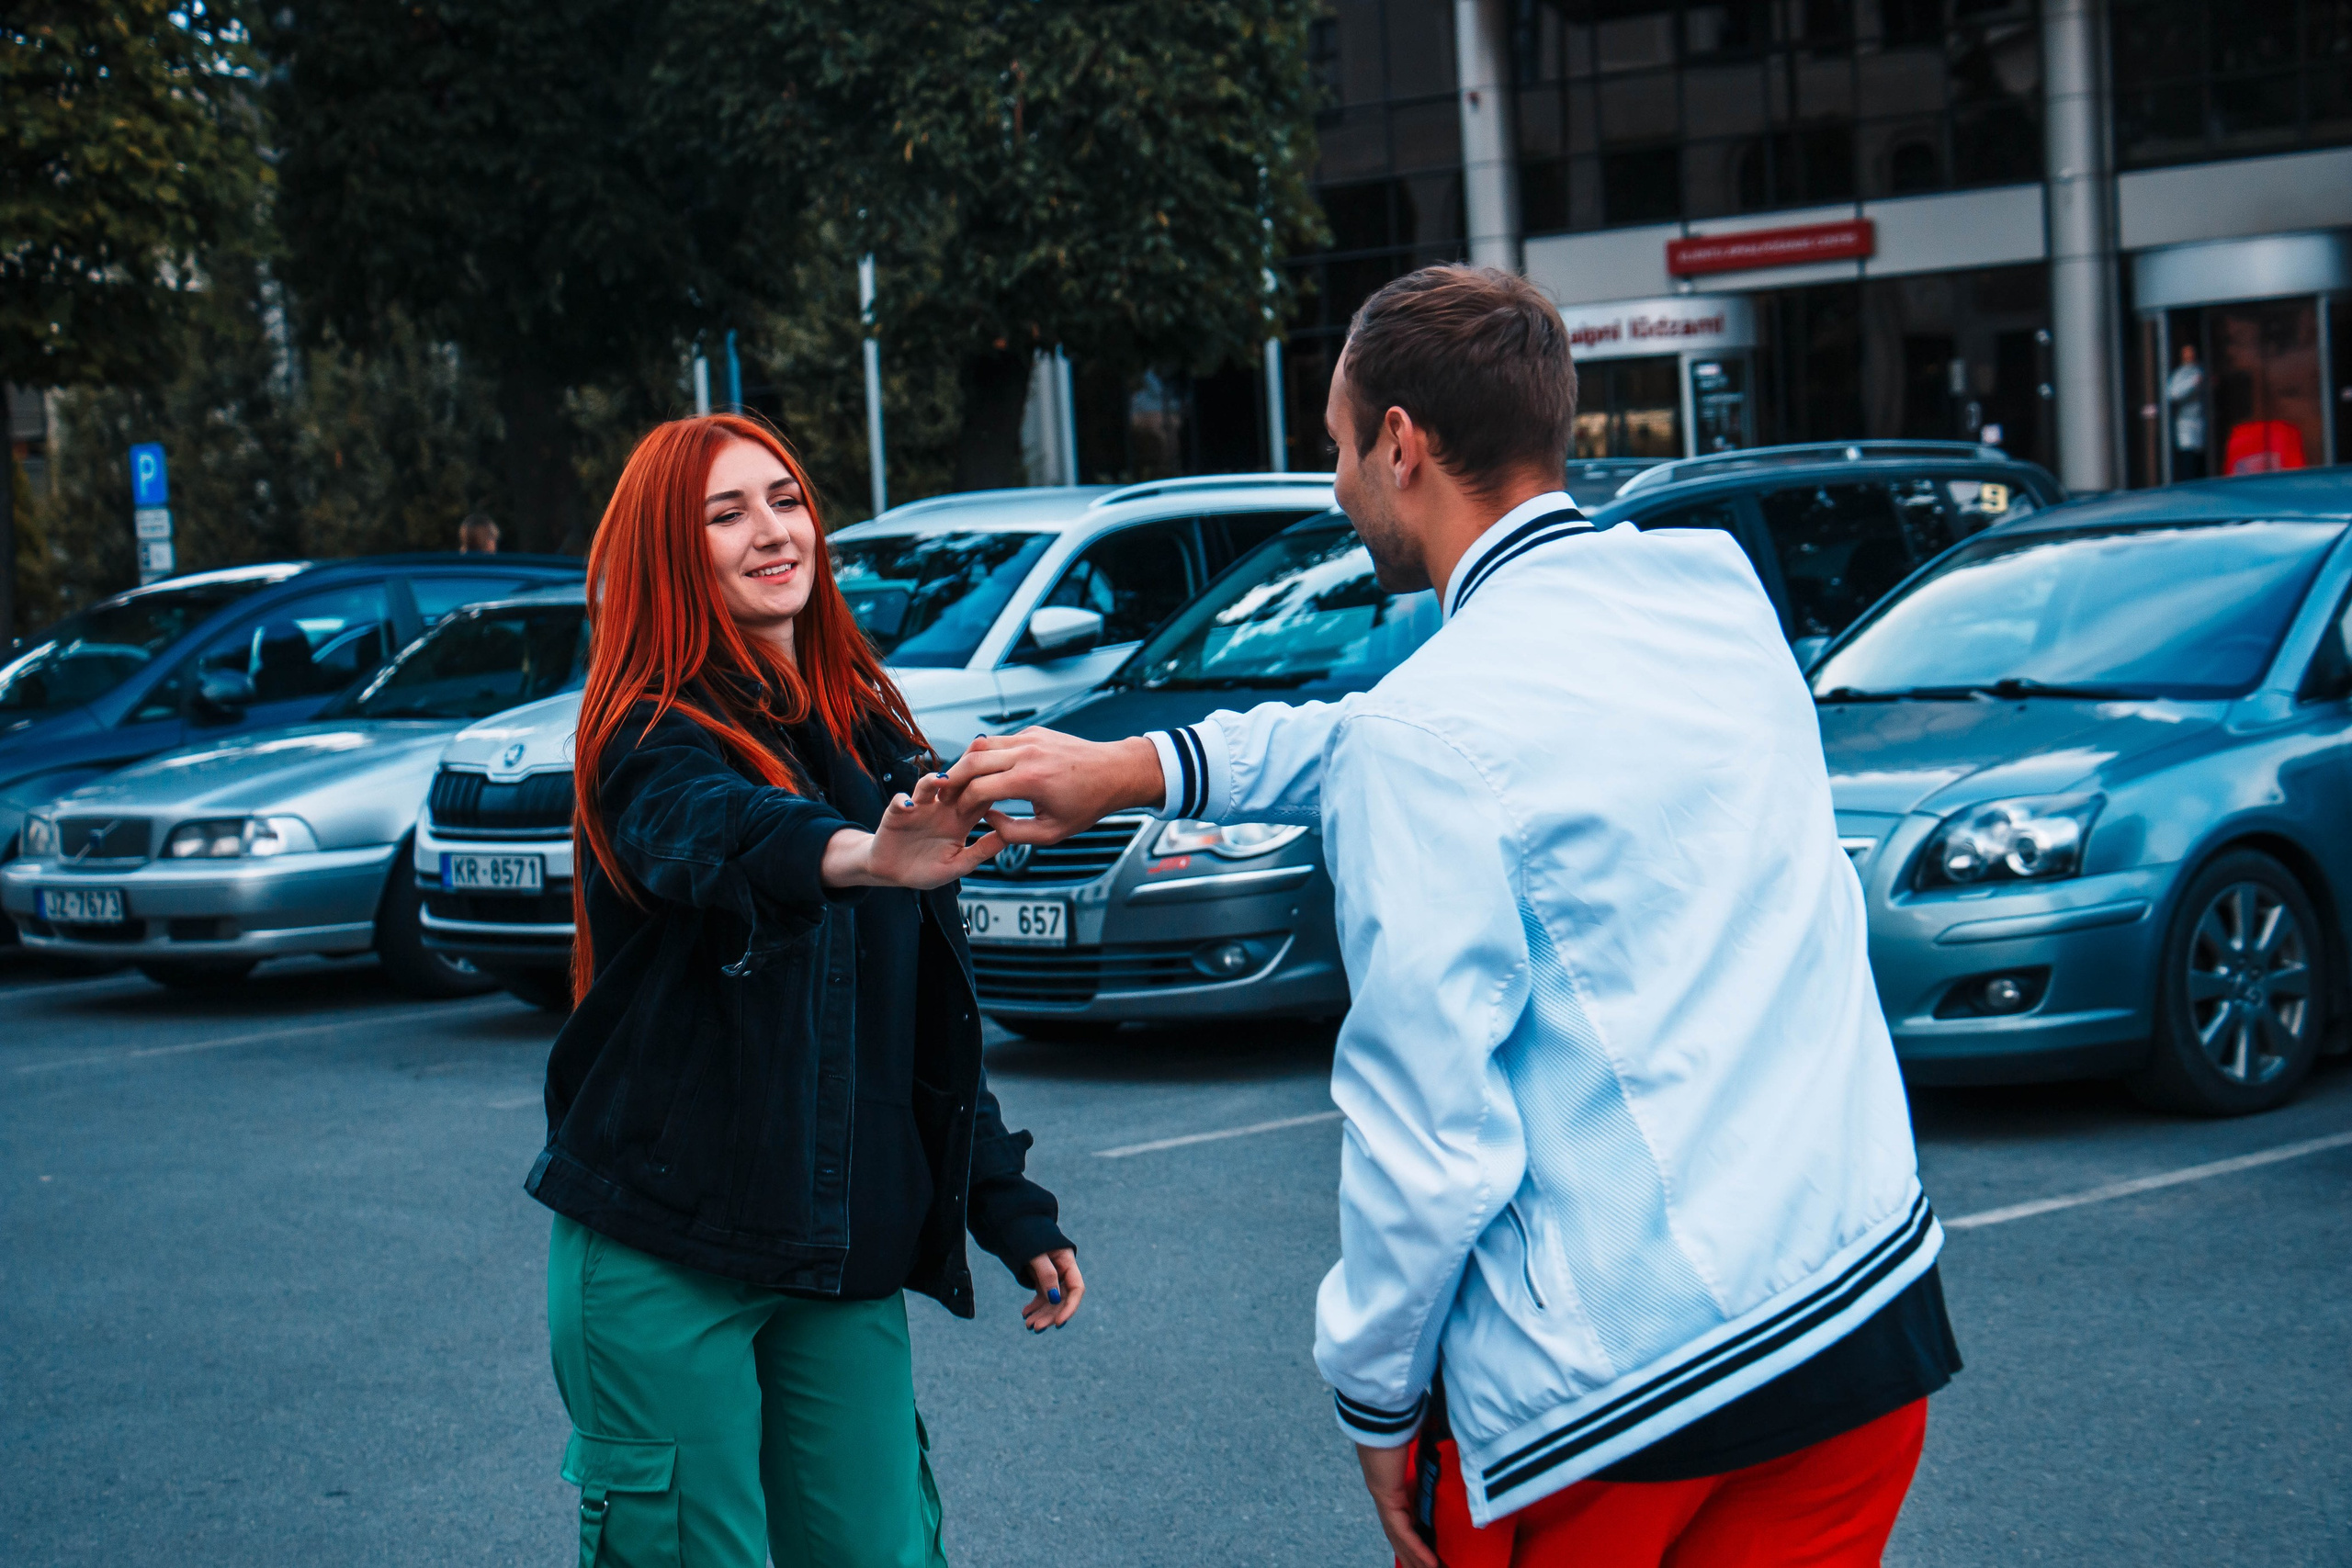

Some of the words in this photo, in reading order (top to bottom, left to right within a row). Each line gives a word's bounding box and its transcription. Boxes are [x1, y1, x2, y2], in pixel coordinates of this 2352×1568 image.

[1570, 318, 1620, 346] aipni
[138, 451, 156, 498] P
[1982, 483, 2007, 514] 9
[454, 856, 536, 885] KR-8571
[1019, 906, 1060, 935] 657
